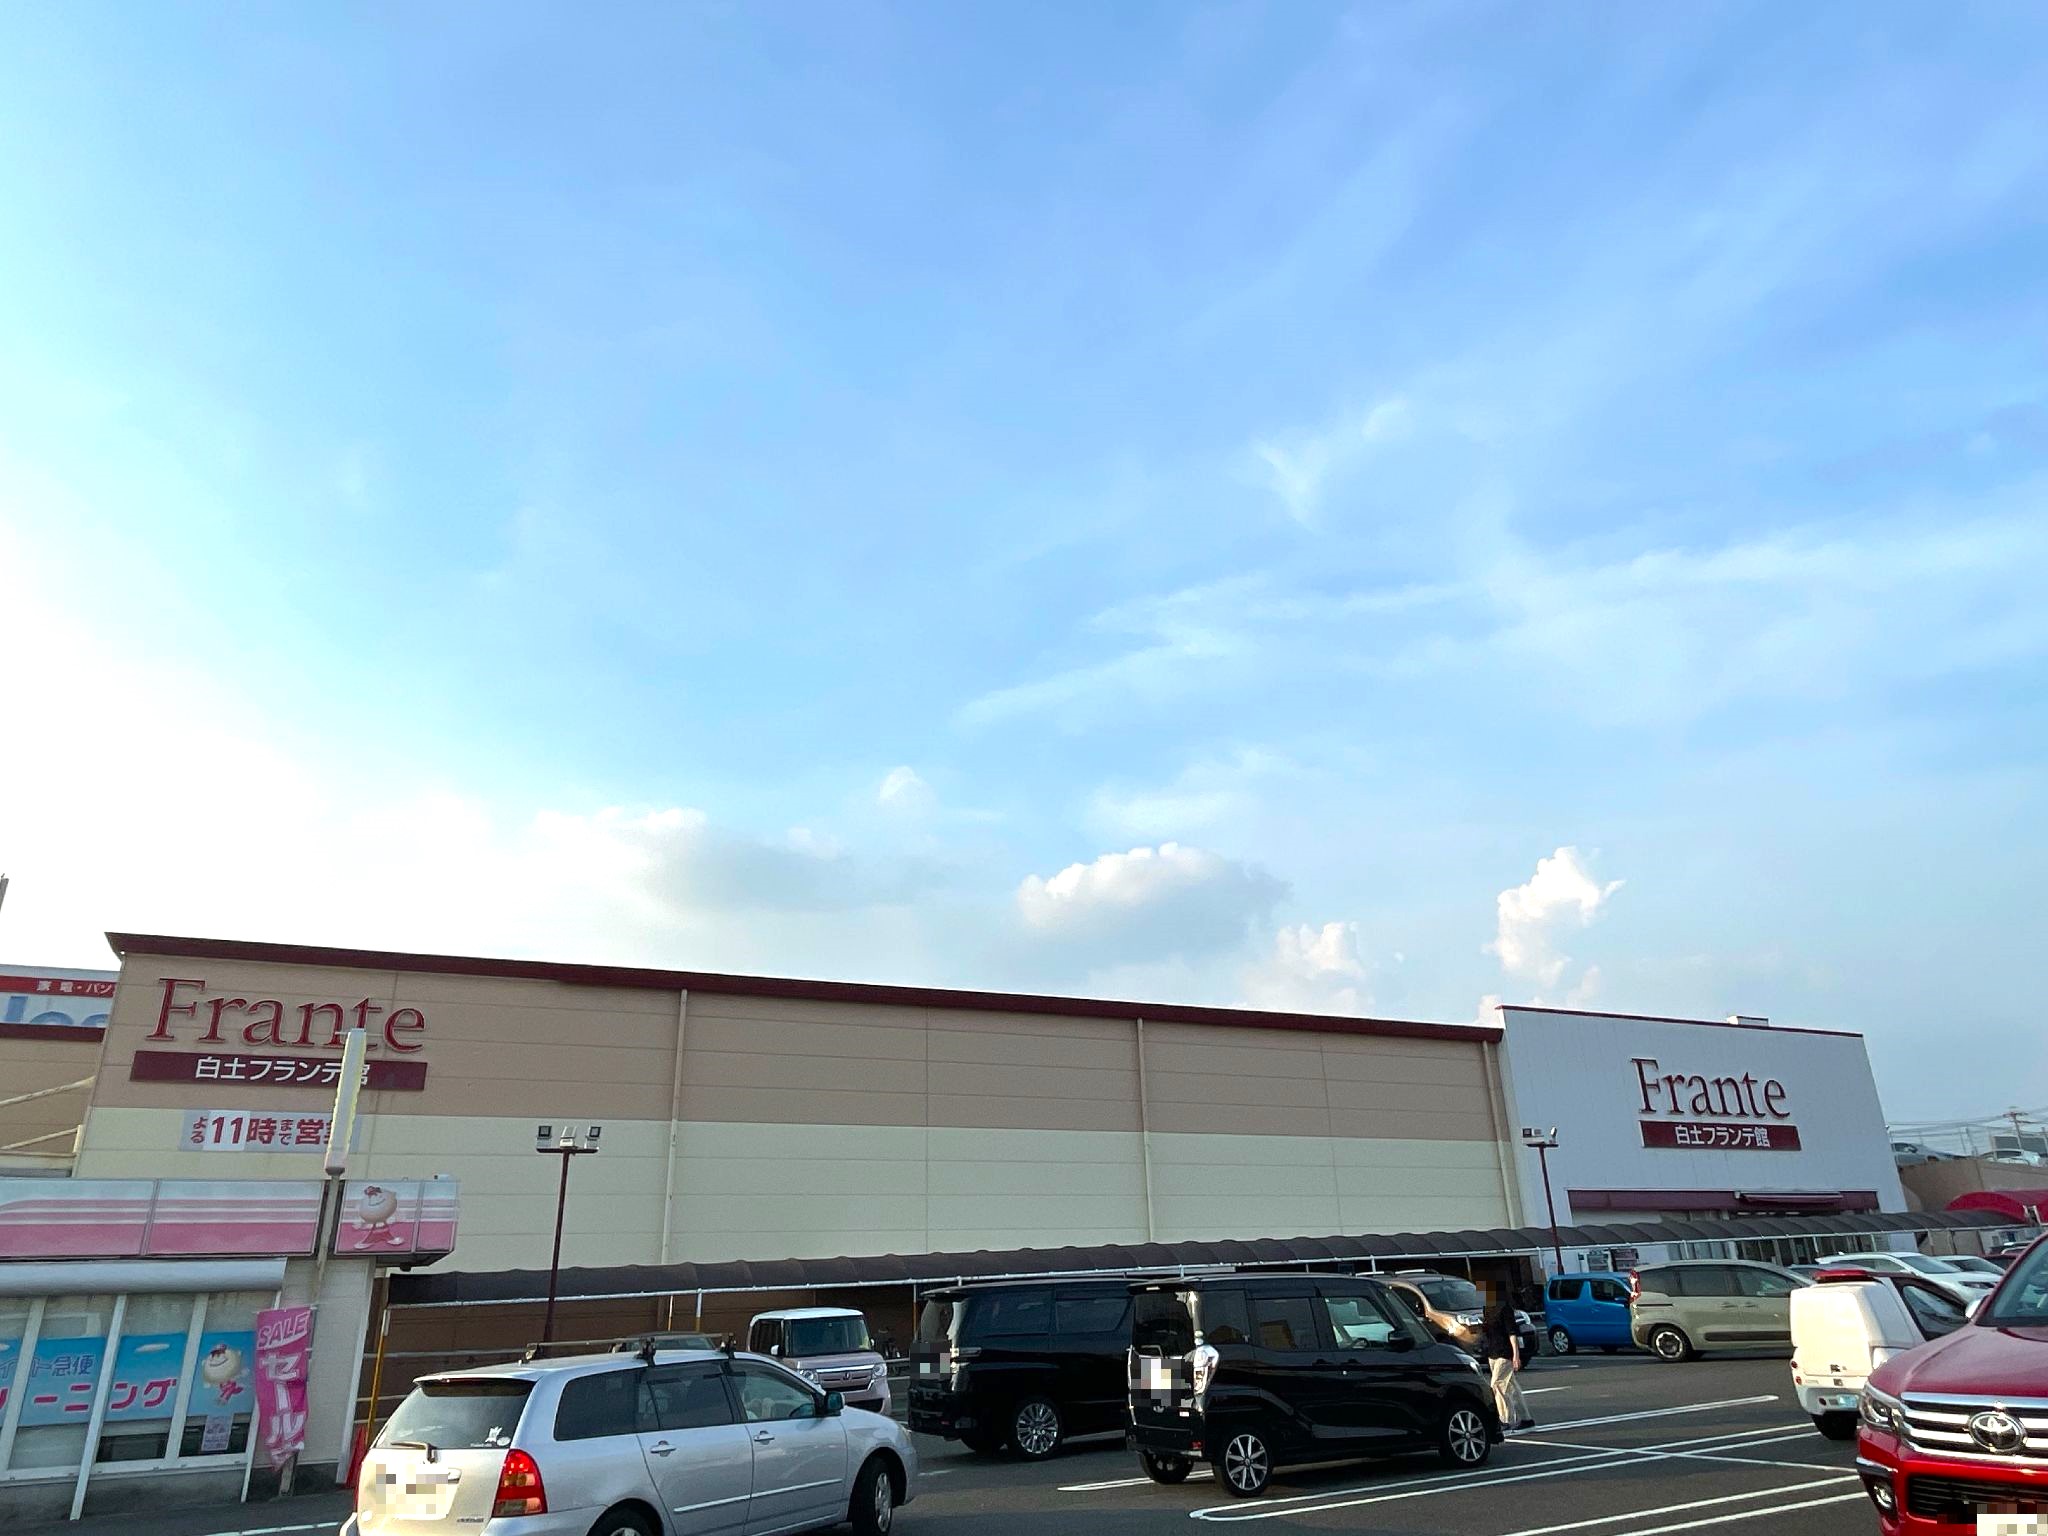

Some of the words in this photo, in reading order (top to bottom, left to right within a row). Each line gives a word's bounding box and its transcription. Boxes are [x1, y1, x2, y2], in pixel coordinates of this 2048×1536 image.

[145, 977, 426, 1053] Frante
[1630, 1057, 1791, 1120] Frante
[1675, 1125, 1771, 1148] 白土フランテ館
[257, 1312, 310, 1350] SALE
[261, 1351, 305, 1446] セール
